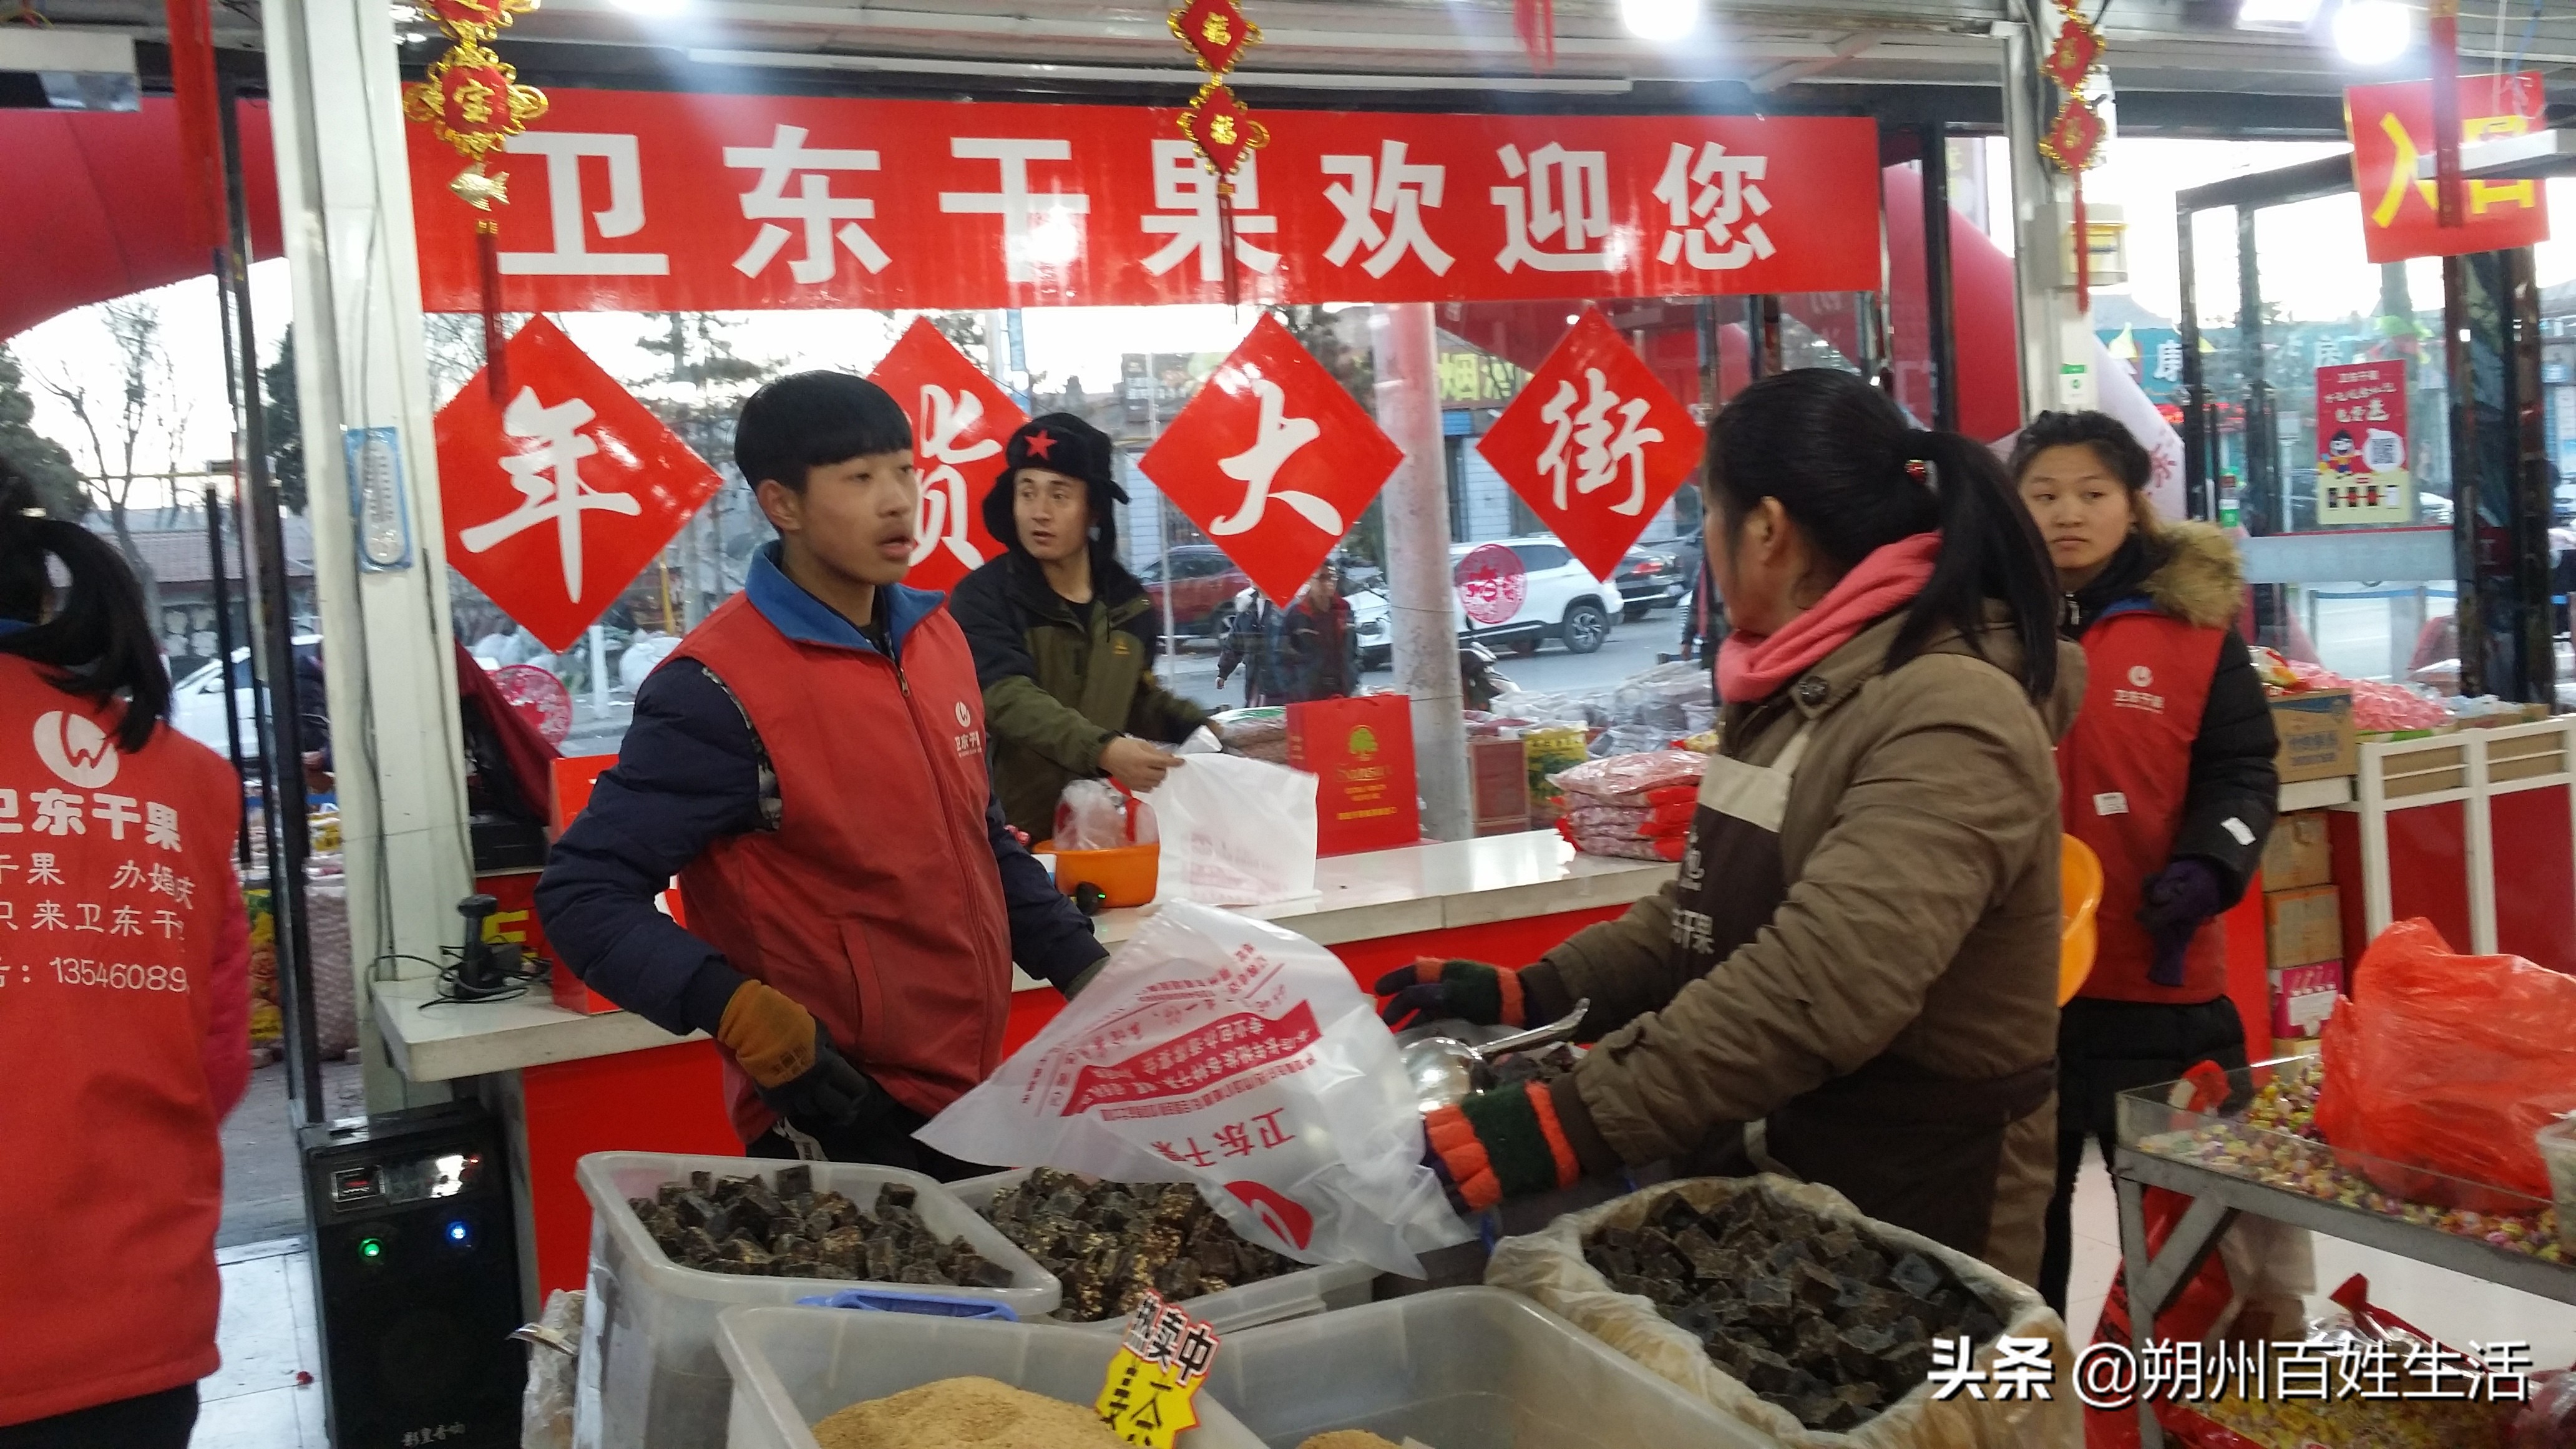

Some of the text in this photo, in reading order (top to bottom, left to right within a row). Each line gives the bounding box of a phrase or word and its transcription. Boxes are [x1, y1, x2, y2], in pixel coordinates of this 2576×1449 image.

[497, 125, 1776, 284] 卫东干果欢迎您
[459, 385, 642, 603] 年
[1209, 379, 1344, 536] 大
[1537, 368, 1664, 516] 街
